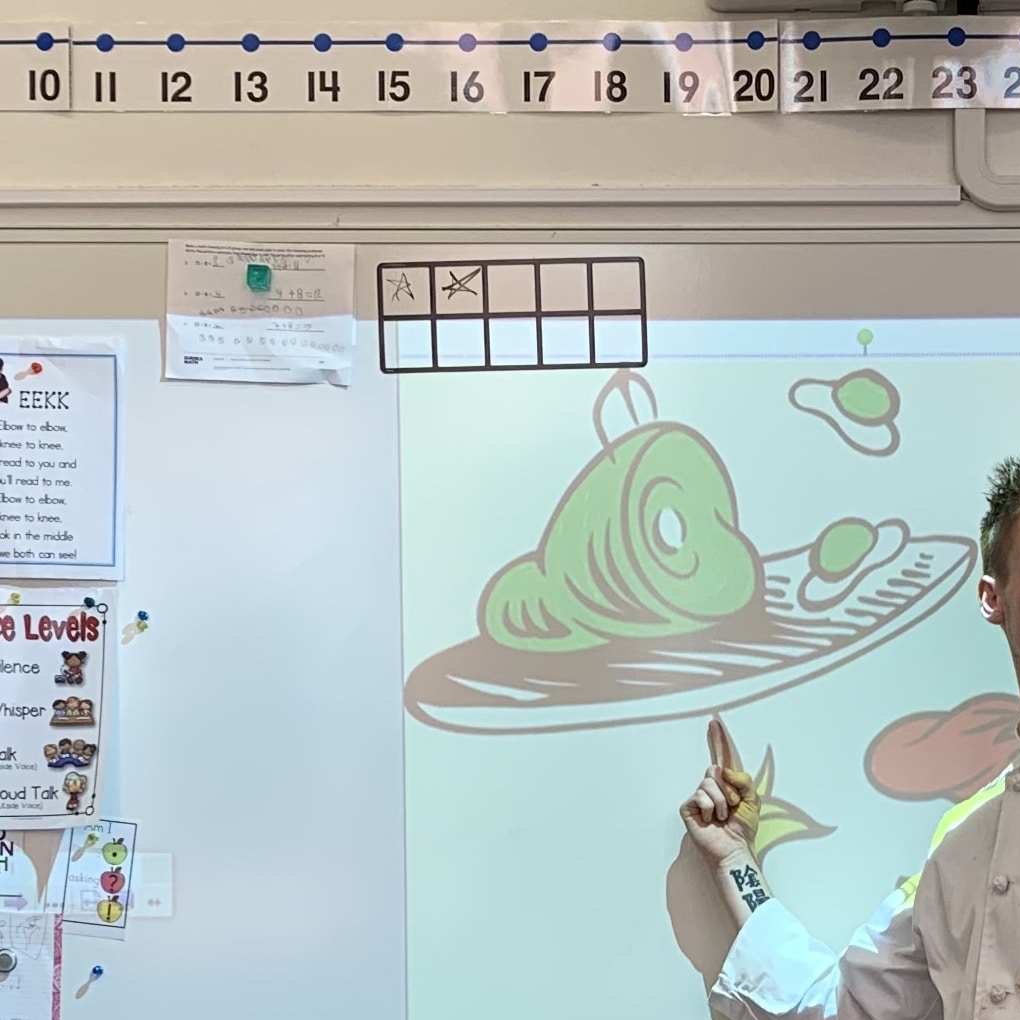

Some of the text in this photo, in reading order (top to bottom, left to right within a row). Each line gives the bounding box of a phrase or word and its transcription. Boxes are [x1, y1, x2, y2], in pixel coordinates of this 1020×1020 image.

[29, 69, 60, 101] 10
[95, 72, 116, 102] 11
[161, 72, 192, 102] 12
[235, 71, 268, 102] 13
[308, 71, 340, 102] 14
[379, 71, 410, 102] 15
[451, 71, 484, 103] 16
[524, 71, 555, 102] 17
[595, 70, 627, 103] 18
[664, 71, 699, 103] 19
[733, 68, 775, 101] 20
[794, 70, 827, 102] 21
[859, 68, 903, 100] 22
[932, 66, 977, 99] 23
[19, 390, 70, 410] EEKK
[27, 423, 37, 431] to
[26, 441, 36, 449] to
[38, 461, 55, 470] you
[59, 458, 77, 468] and
[15, 475, 39, 485] read
[42, 478, 52, 486] to
[0, 492, 22, 503] lbow
[25, 496, 35, 504] to
[25, 514, 35, 522] to
[25, 530, 41, 540] the
[43, 531, 74, 541] middle
[13, 547, 35, 558] both
[39, 551, 55, 559] can
[59, 549, 77, 560] see!
[23, 611, 100, 642] Levels
[0, 660, 40, 674] lence
[0, 702, 46, 720] hisper
[31, 786, 59, 800] Talk
